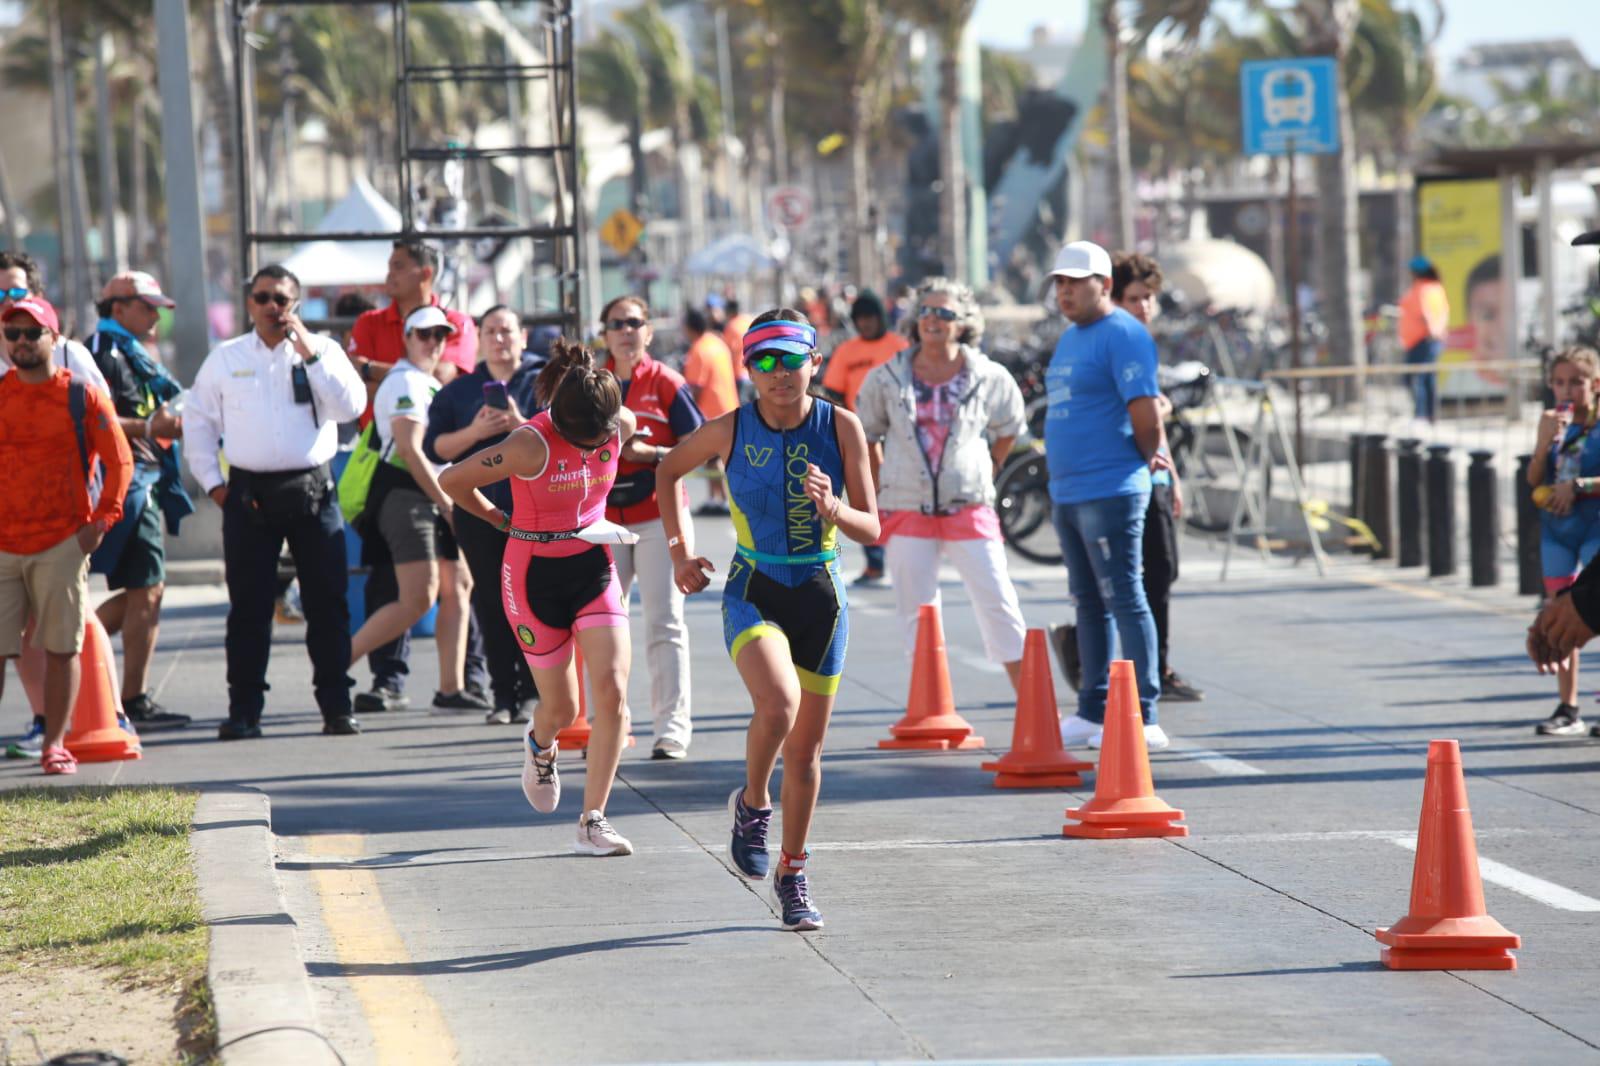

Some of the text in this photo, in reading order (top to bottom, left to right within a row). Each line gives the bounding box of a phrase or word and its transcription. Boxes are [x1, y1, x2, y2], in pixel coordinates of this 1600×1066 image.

[548, 473, 616, 493] CHIHUAHU
[550, 468, 592, 483] UNITRI
[786, 443, 814, 552] VIKINGOS
